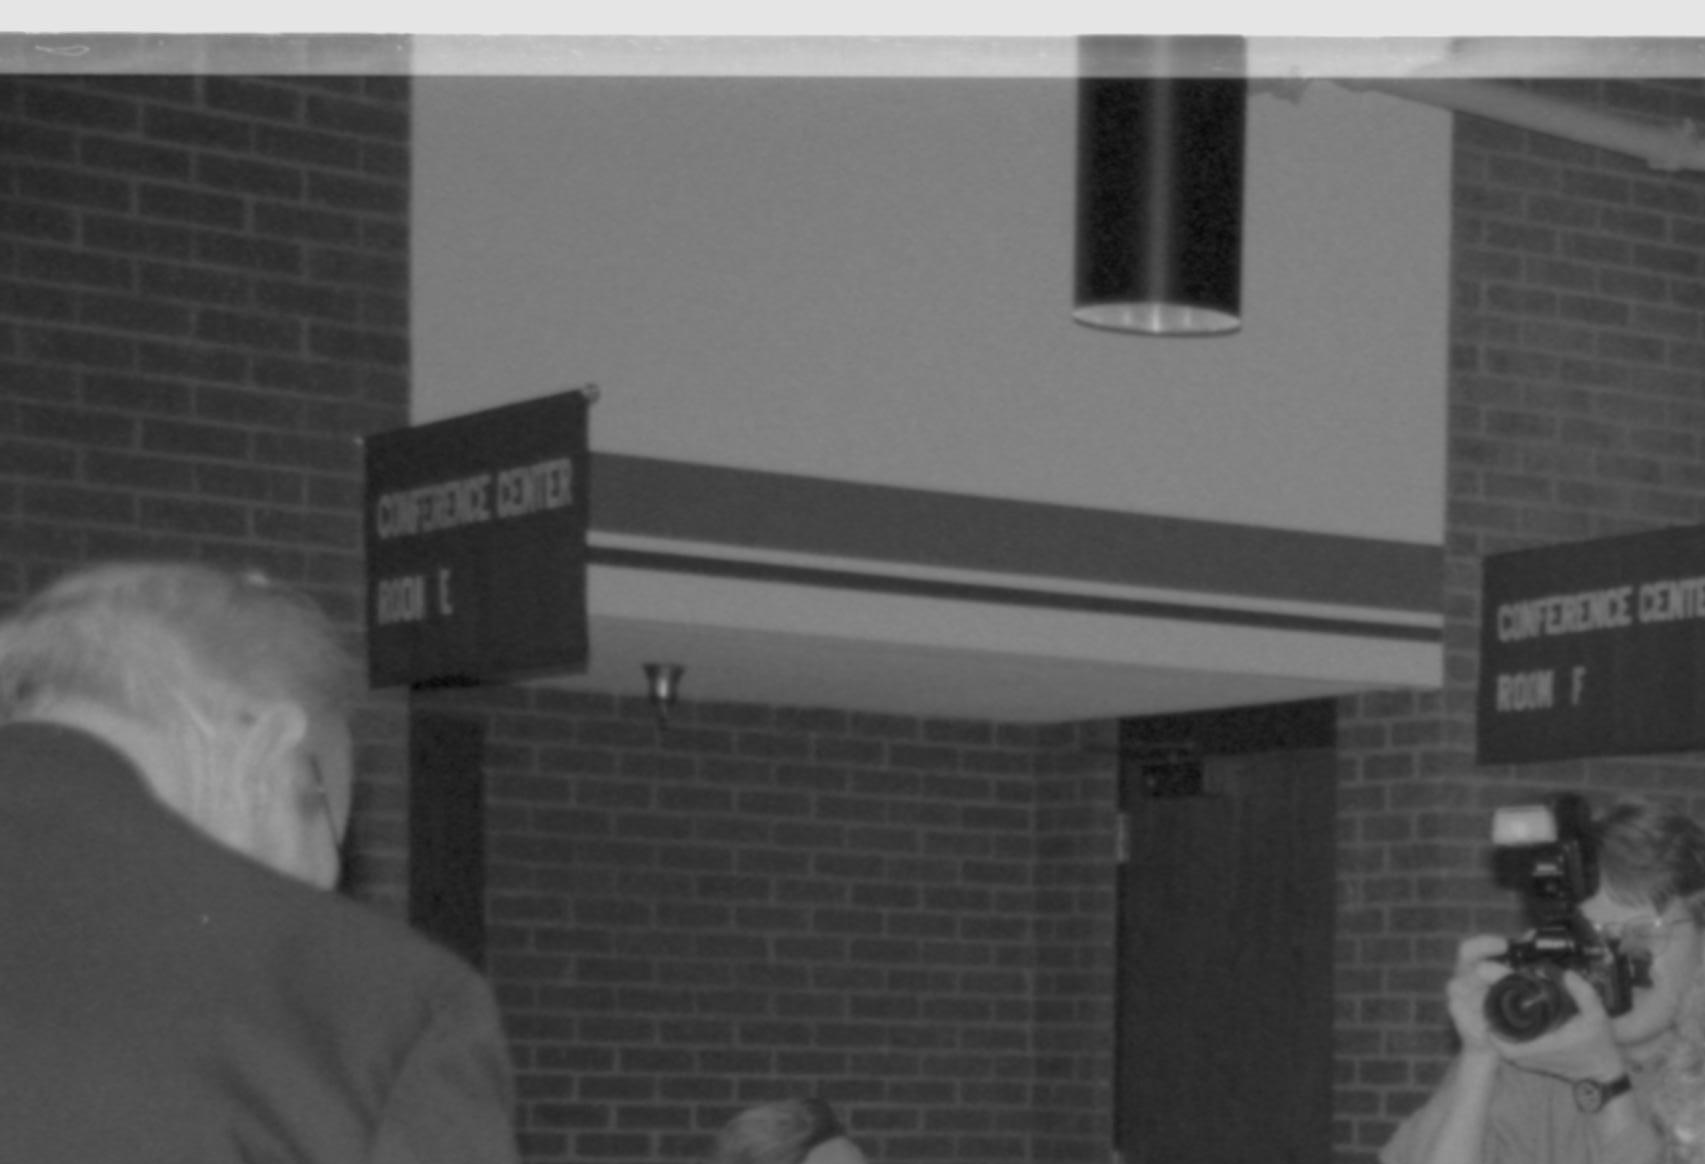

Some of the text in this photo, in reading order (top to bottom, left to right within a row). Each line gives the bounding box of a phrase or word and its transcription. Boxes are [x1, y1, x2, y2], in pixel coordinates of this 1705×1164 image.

[377, 457, 573, 540] CONFERENCE CENTER
[377, 574, 426, 626] ROOM
[1497, 583, 1634, 643] CONFERENCE
[1495, 665, 1587, 713] ROOM F
